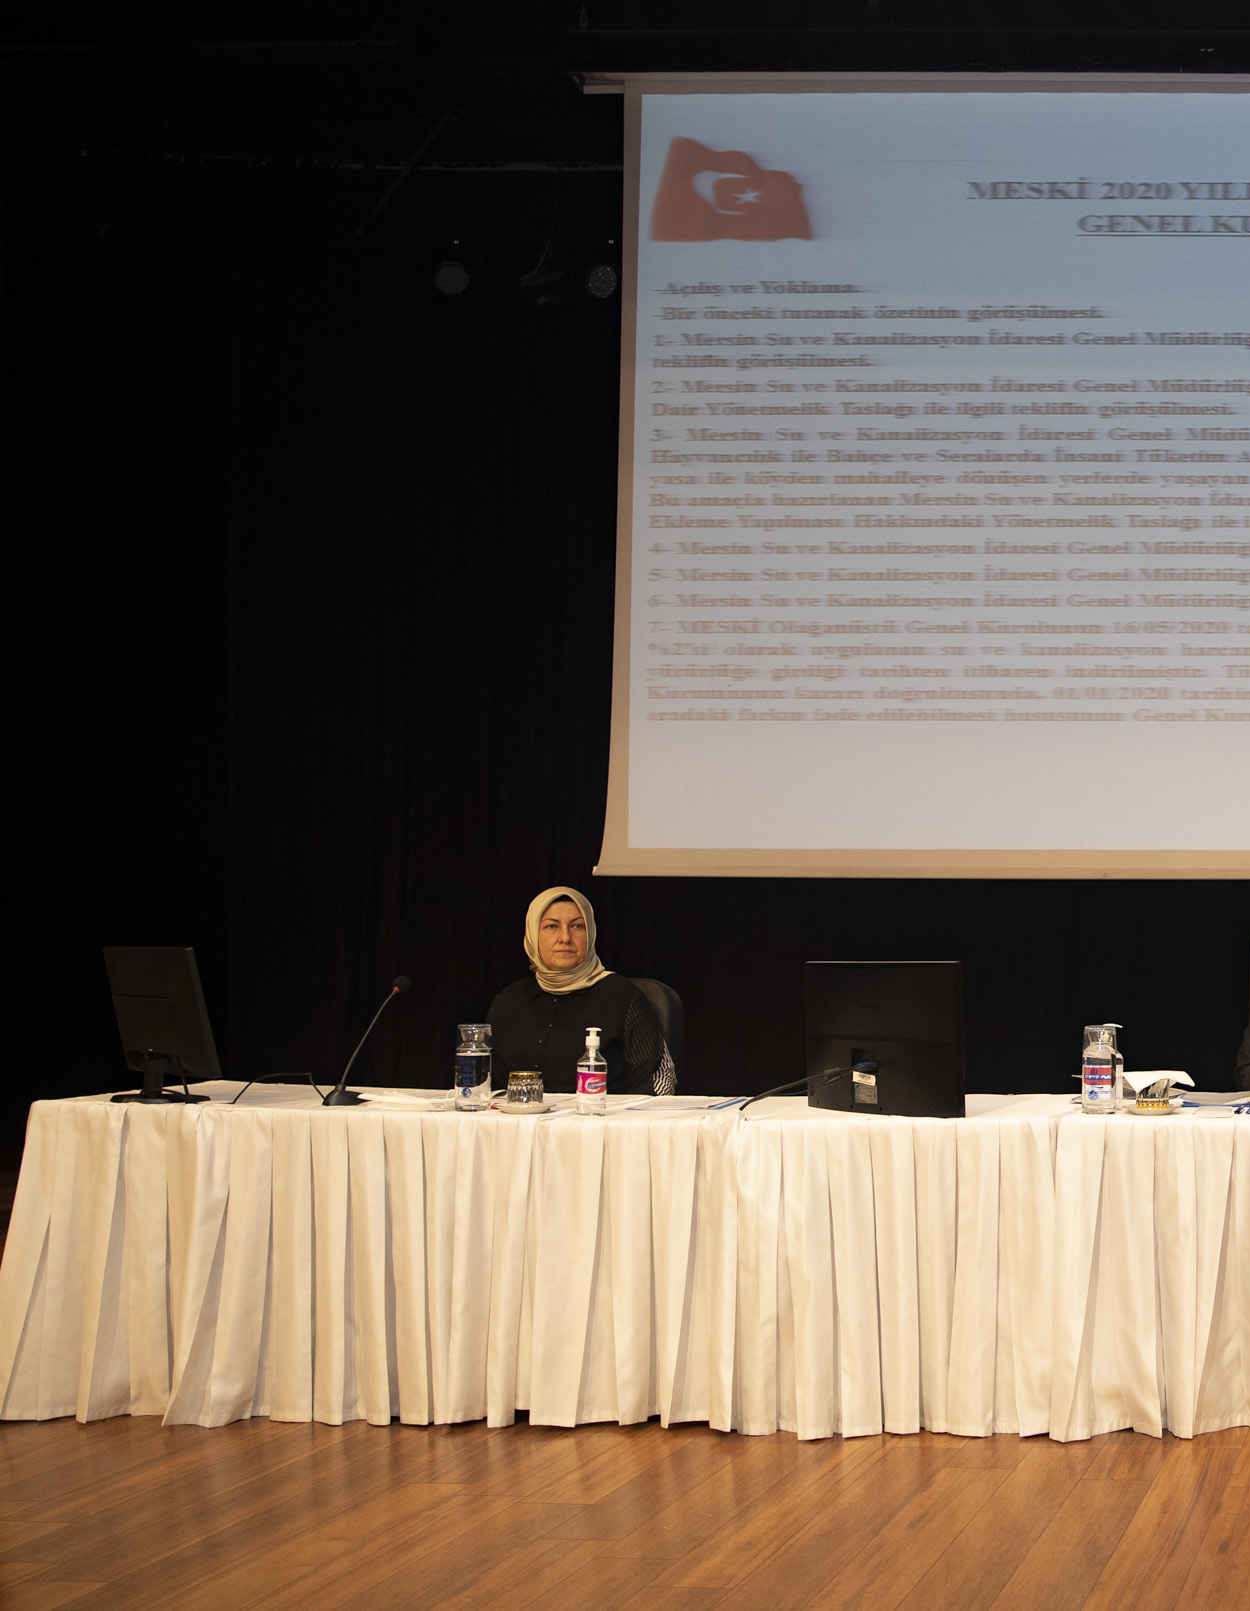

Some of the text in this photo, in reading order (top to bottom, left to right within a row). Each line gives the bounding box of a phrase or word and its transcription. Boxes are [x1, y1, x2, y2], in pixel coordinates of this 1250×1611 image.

[968, 176, 1090, 201] MESKİ
[1100, 181, 1172, 201] 2020
[1077, 213, 1205, 236] GENEL
[729, 283, 753, 294] ve
[681, 332, 755, 346] Mersin
[765, 332, 794, 346] Su
[799, 335, 823, 346] ve
[988, 329, 1064, 346] İdaresi
[1073, 332, 1138, 346] Genel
[681, 379, 756, 392] Mersin
[766, 379, 795, 392] Su
[801, 382, 824, 393] ve
[990, 376, 1065, 393] İdaresi
[1074, 379, 1139, 393] Genel
[923, 402, 949, 415] ile
[685, 428, 762, 441] Mersin
[776, 428, 805, 441] Su
[818, 431, 842, 441] ve
[1018, 424, 1094, 441] İdaresi
[1108, 428, 1172, 441] Genel
[791, 449, 818, 463] ile
[901, 452, 926, 463] ve
[709, 471, 734, 485] ile
[899, 493, 977, 506] Mersin
[984, 493, 1010, 506] Su
[1019, 496, 1044, 506] ve
[1211, 515, 1237, 528] ile
[677, 541, 751, 555] Mersin
[761, 541, 789, 555] Su
[796, 544, 821, 555] ve
[984, 538, 1060, 555] İdaresi
[1067, 542, 1130, 555] Genel
[677, 568, 751, 581] Mersin
[760, 568, 789, 582] Su
[796, 571, 821, 582] ve
[984, 565, 1059, 582] İdaresi
[1067, 569, 1129, 582] Genel
[677, 594, 751, 607] Mersin
[760, 594, 789, 607] Su
[796, 597, 821, 607] ve
[984, 591, 1059, 608] İdaresi
[1067, 594, 1129, 608] Genel
